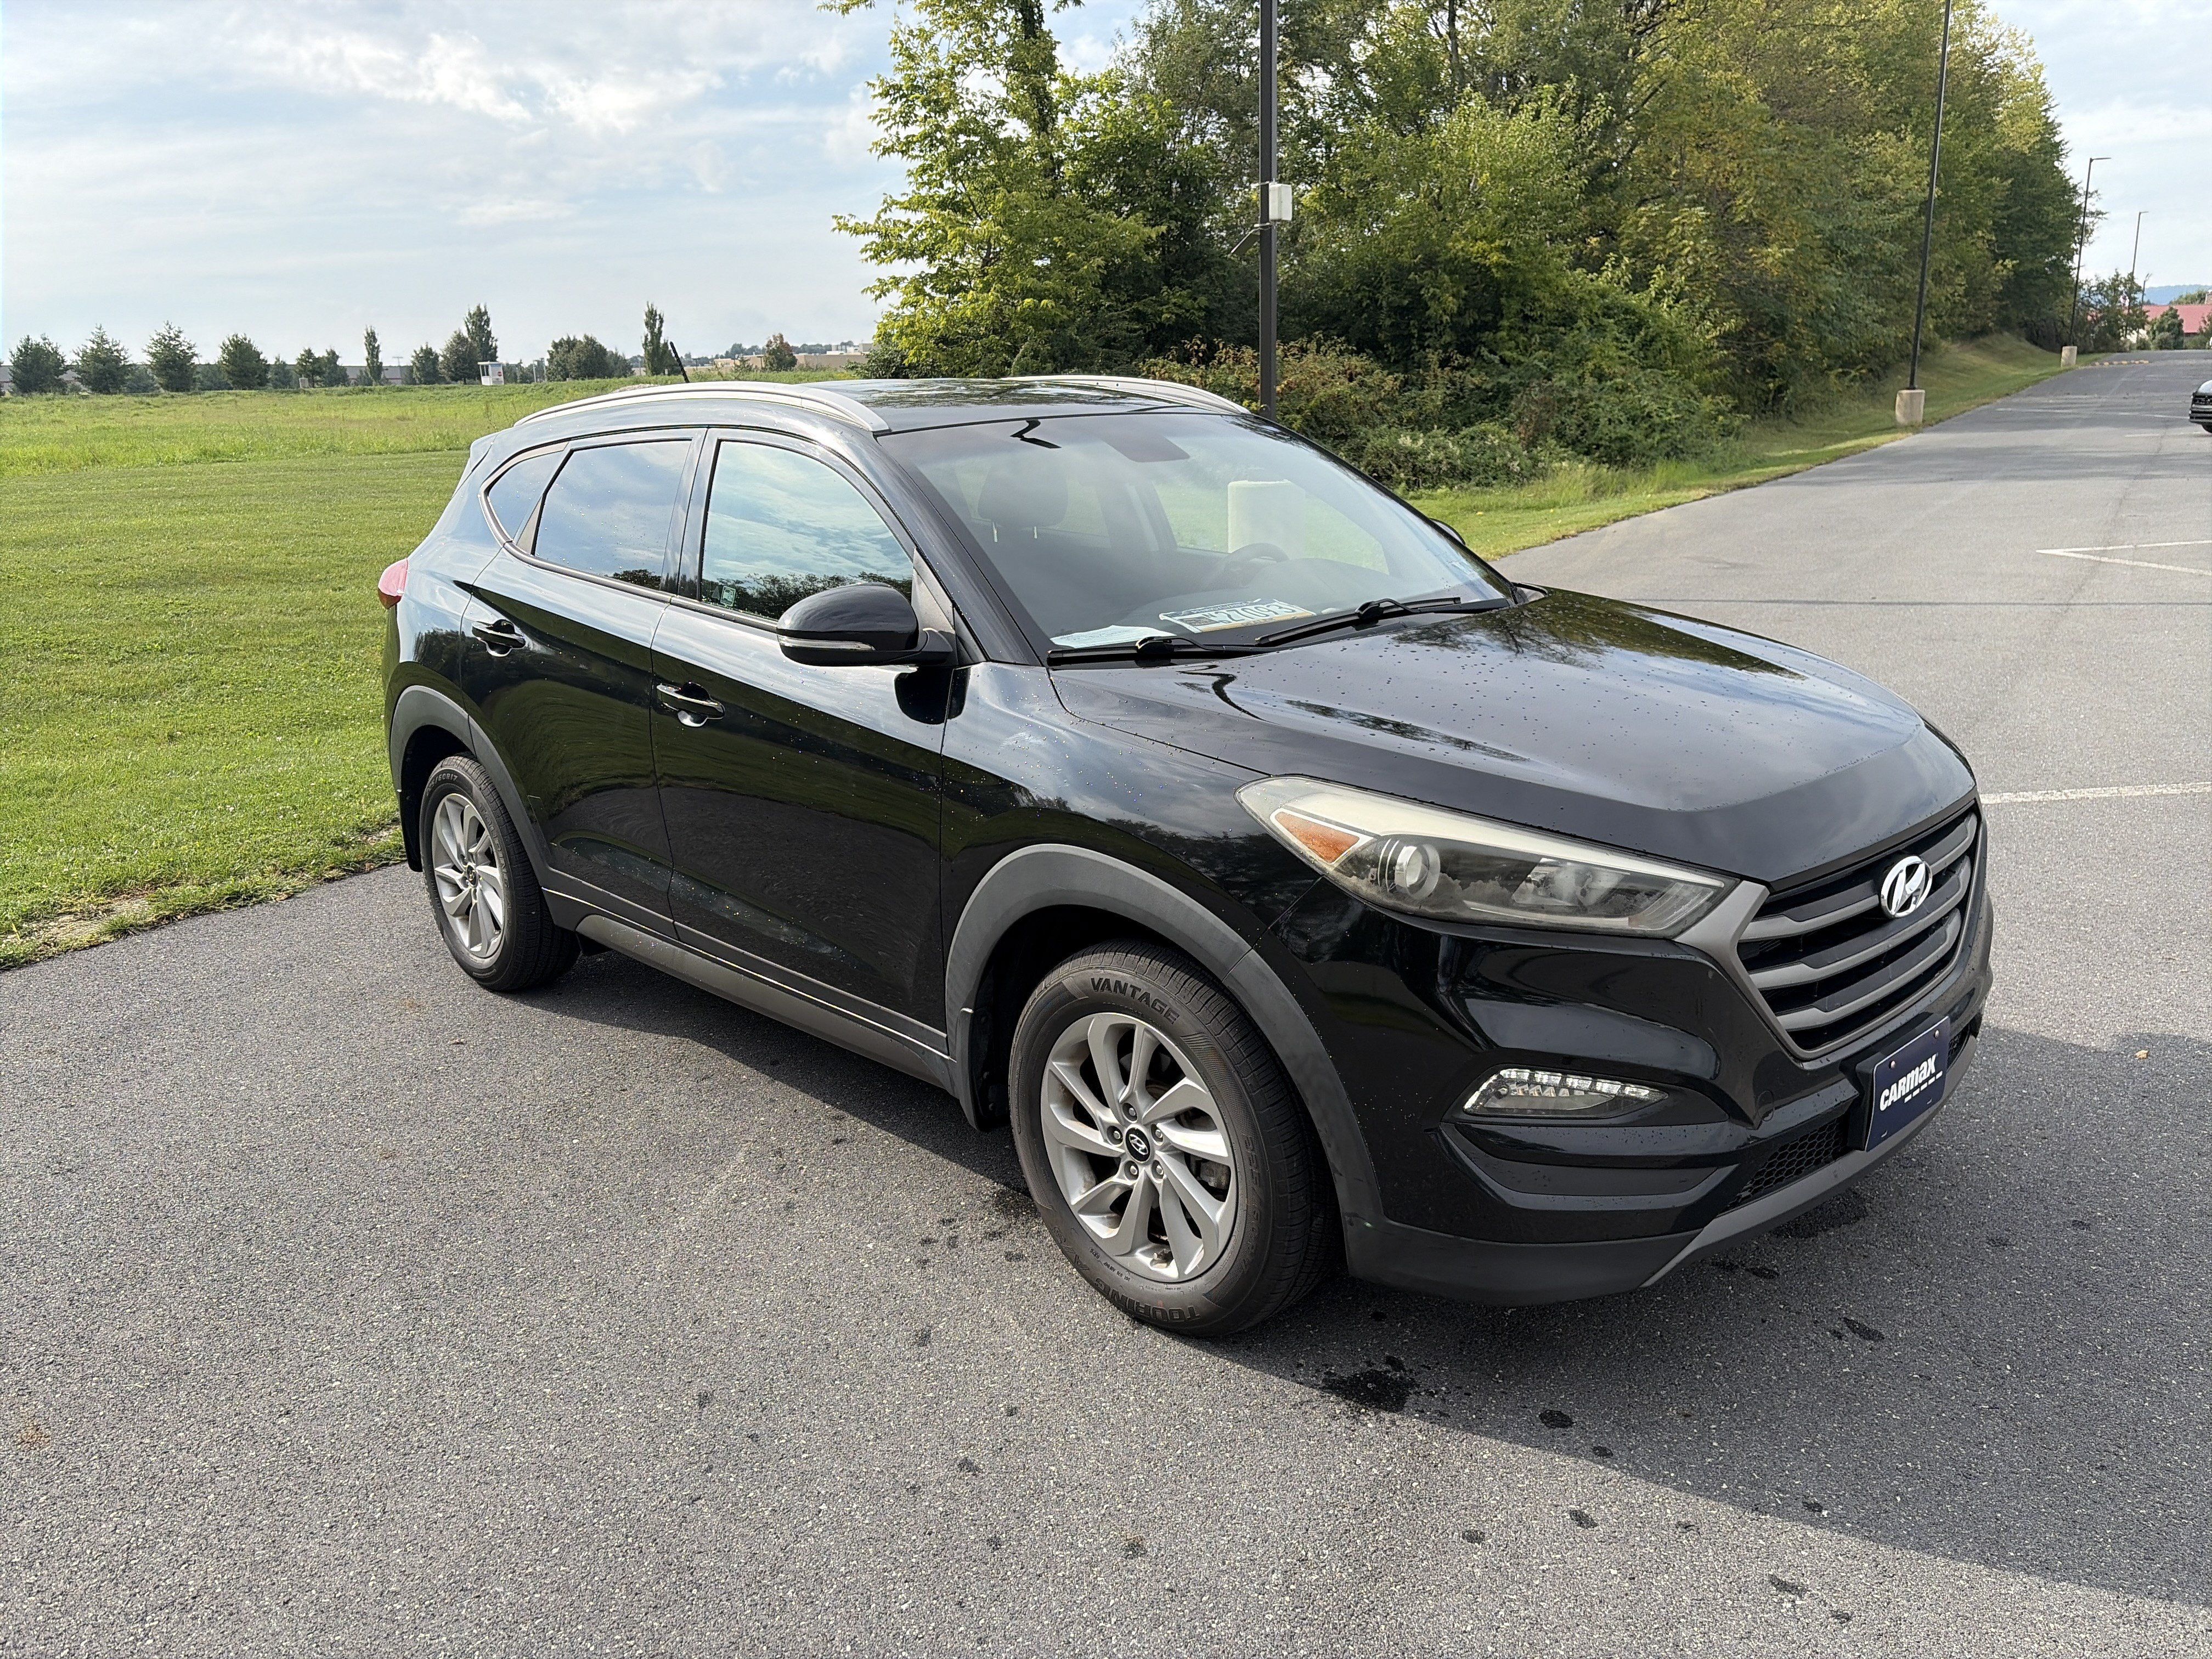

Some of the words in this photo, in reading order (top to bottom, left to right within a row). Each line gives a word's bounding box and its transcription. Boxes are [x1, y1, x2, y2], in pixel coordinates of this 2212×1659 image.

[1214, 604, 1296, 622] 27093
[1091, 977, 1180, 1025] VANTAGE
[1094, 1277, 1201, 1322] TOURING
